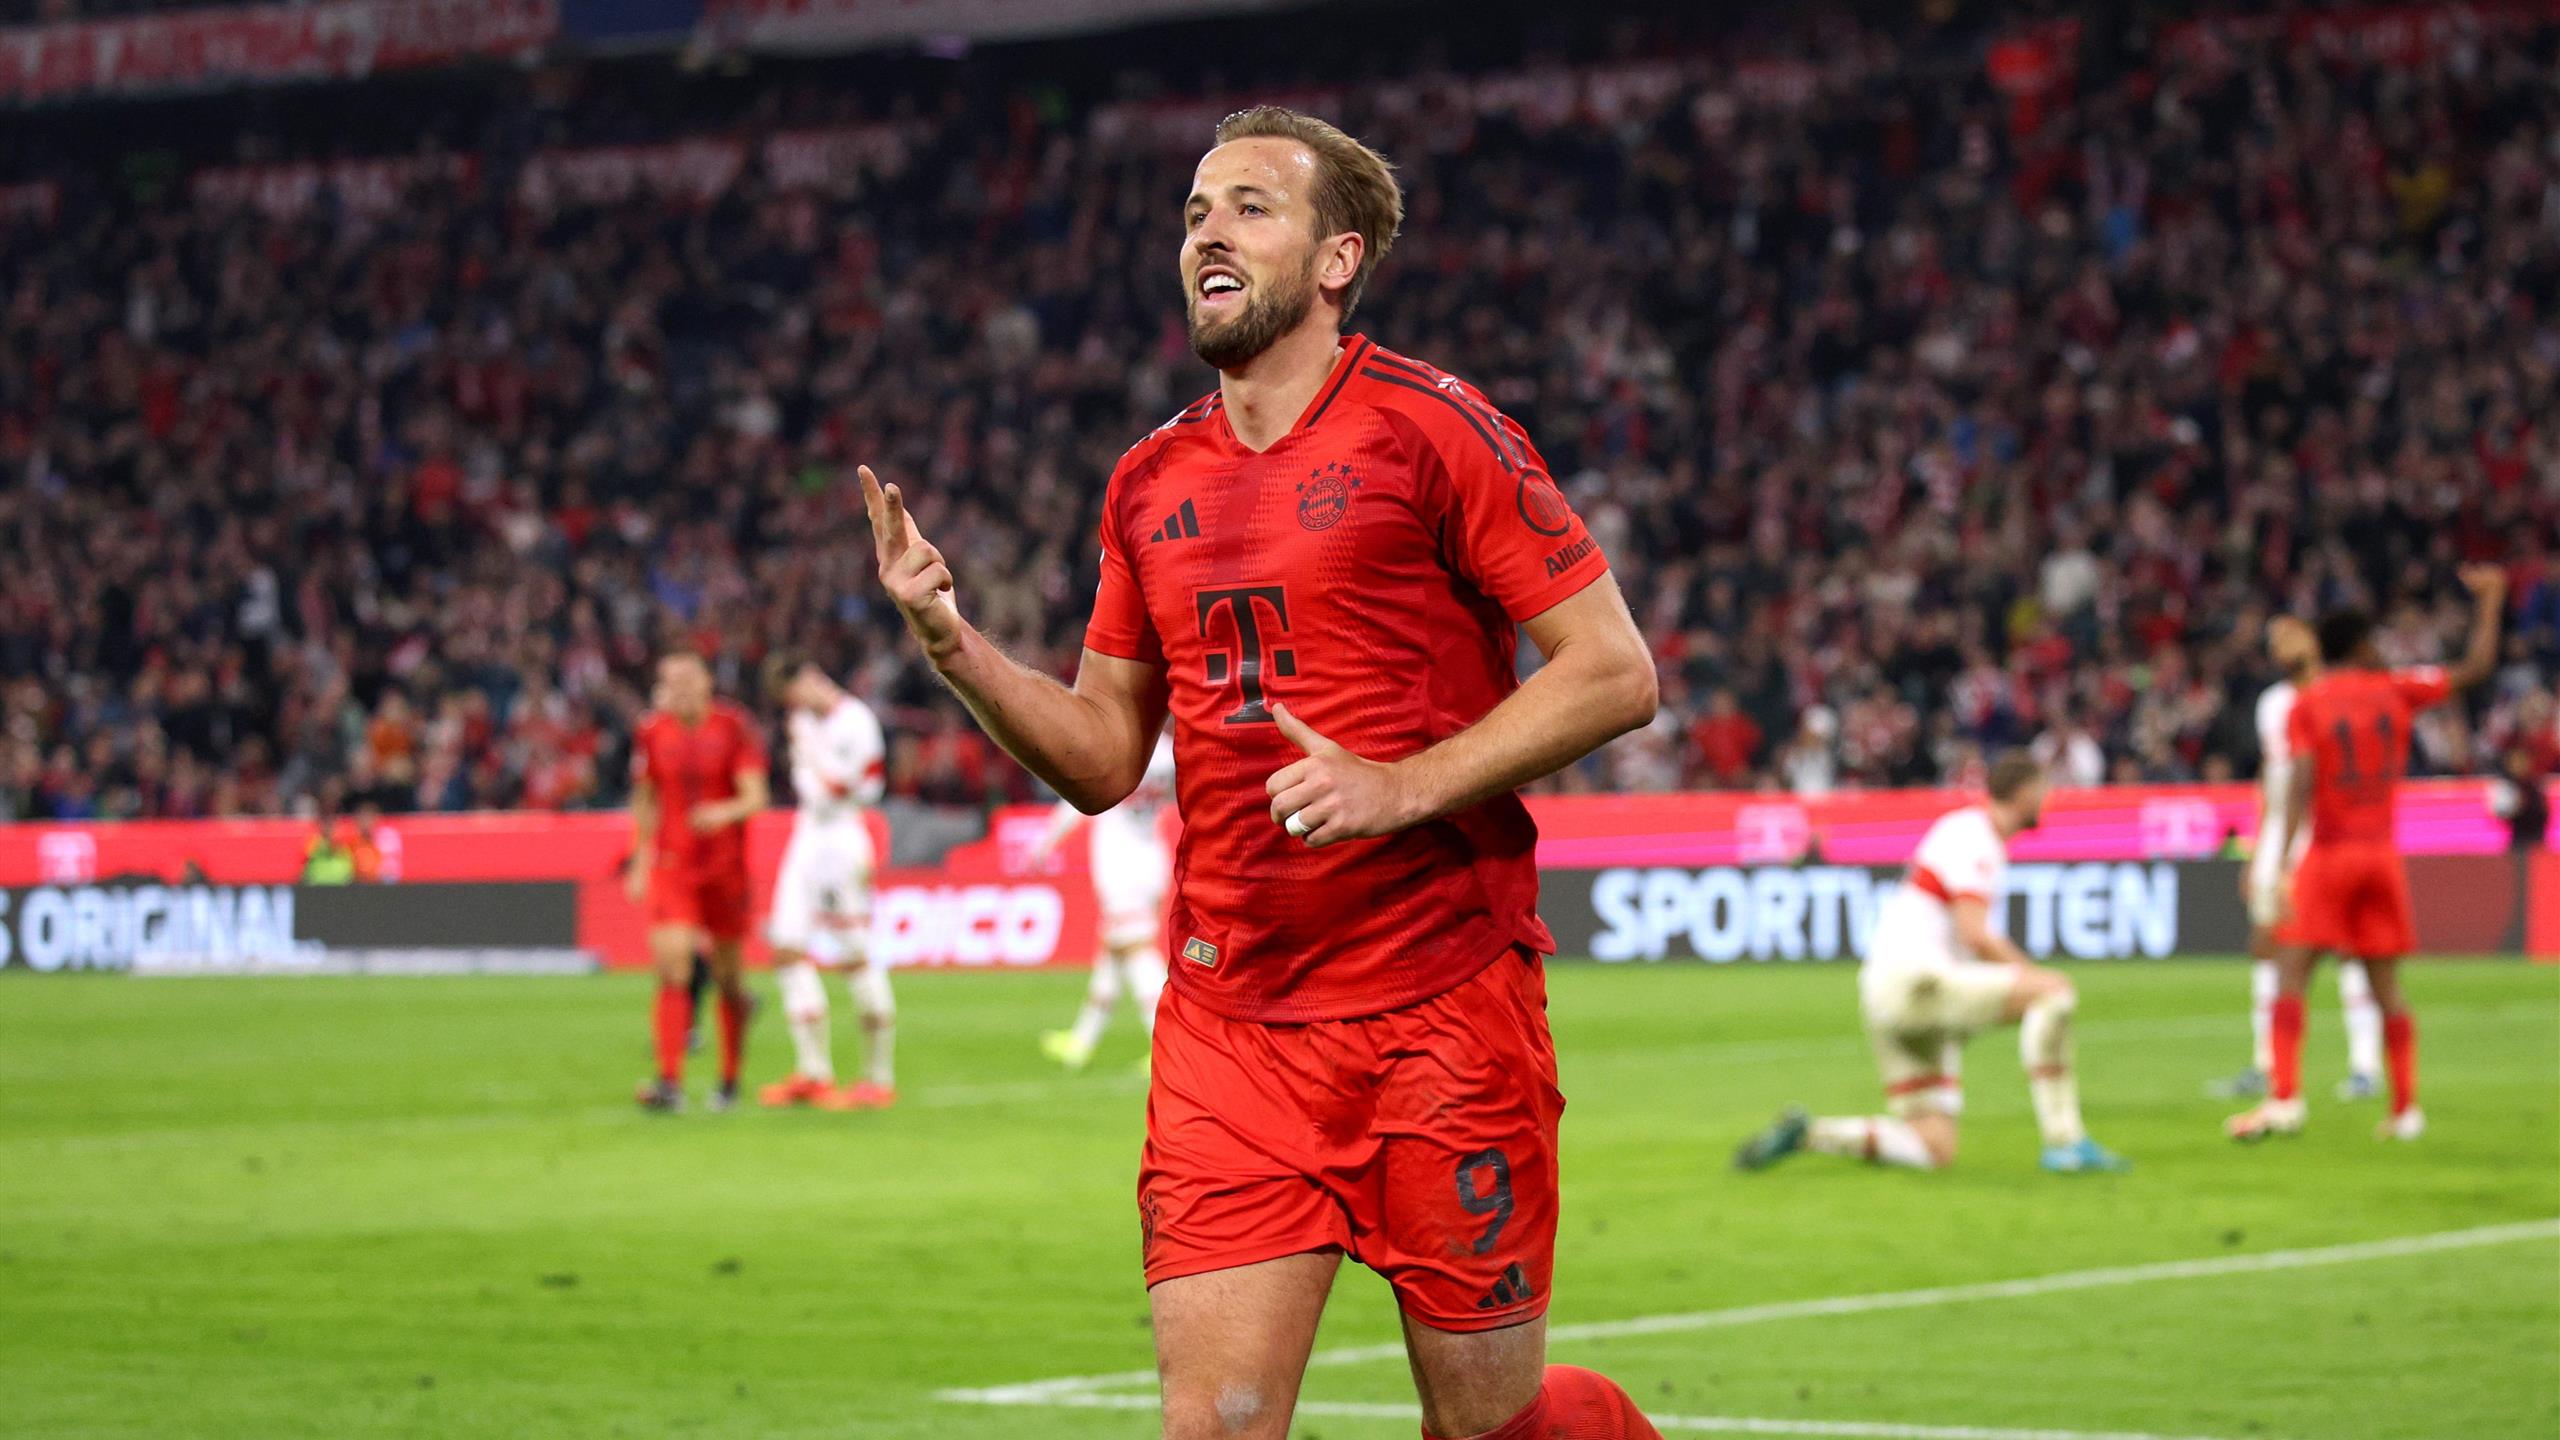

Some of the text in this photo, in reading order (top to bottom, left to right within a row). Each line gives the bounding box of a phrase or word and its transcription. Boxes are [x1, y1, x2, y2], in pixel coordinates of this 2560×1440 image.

[1197, 585, 1298, 725] T
[2328, 712, 2401, 788] 11
[1591, 861, 2179, 960] SPORTWTTEN
[1455, 1147, 1515, 1255] 9
